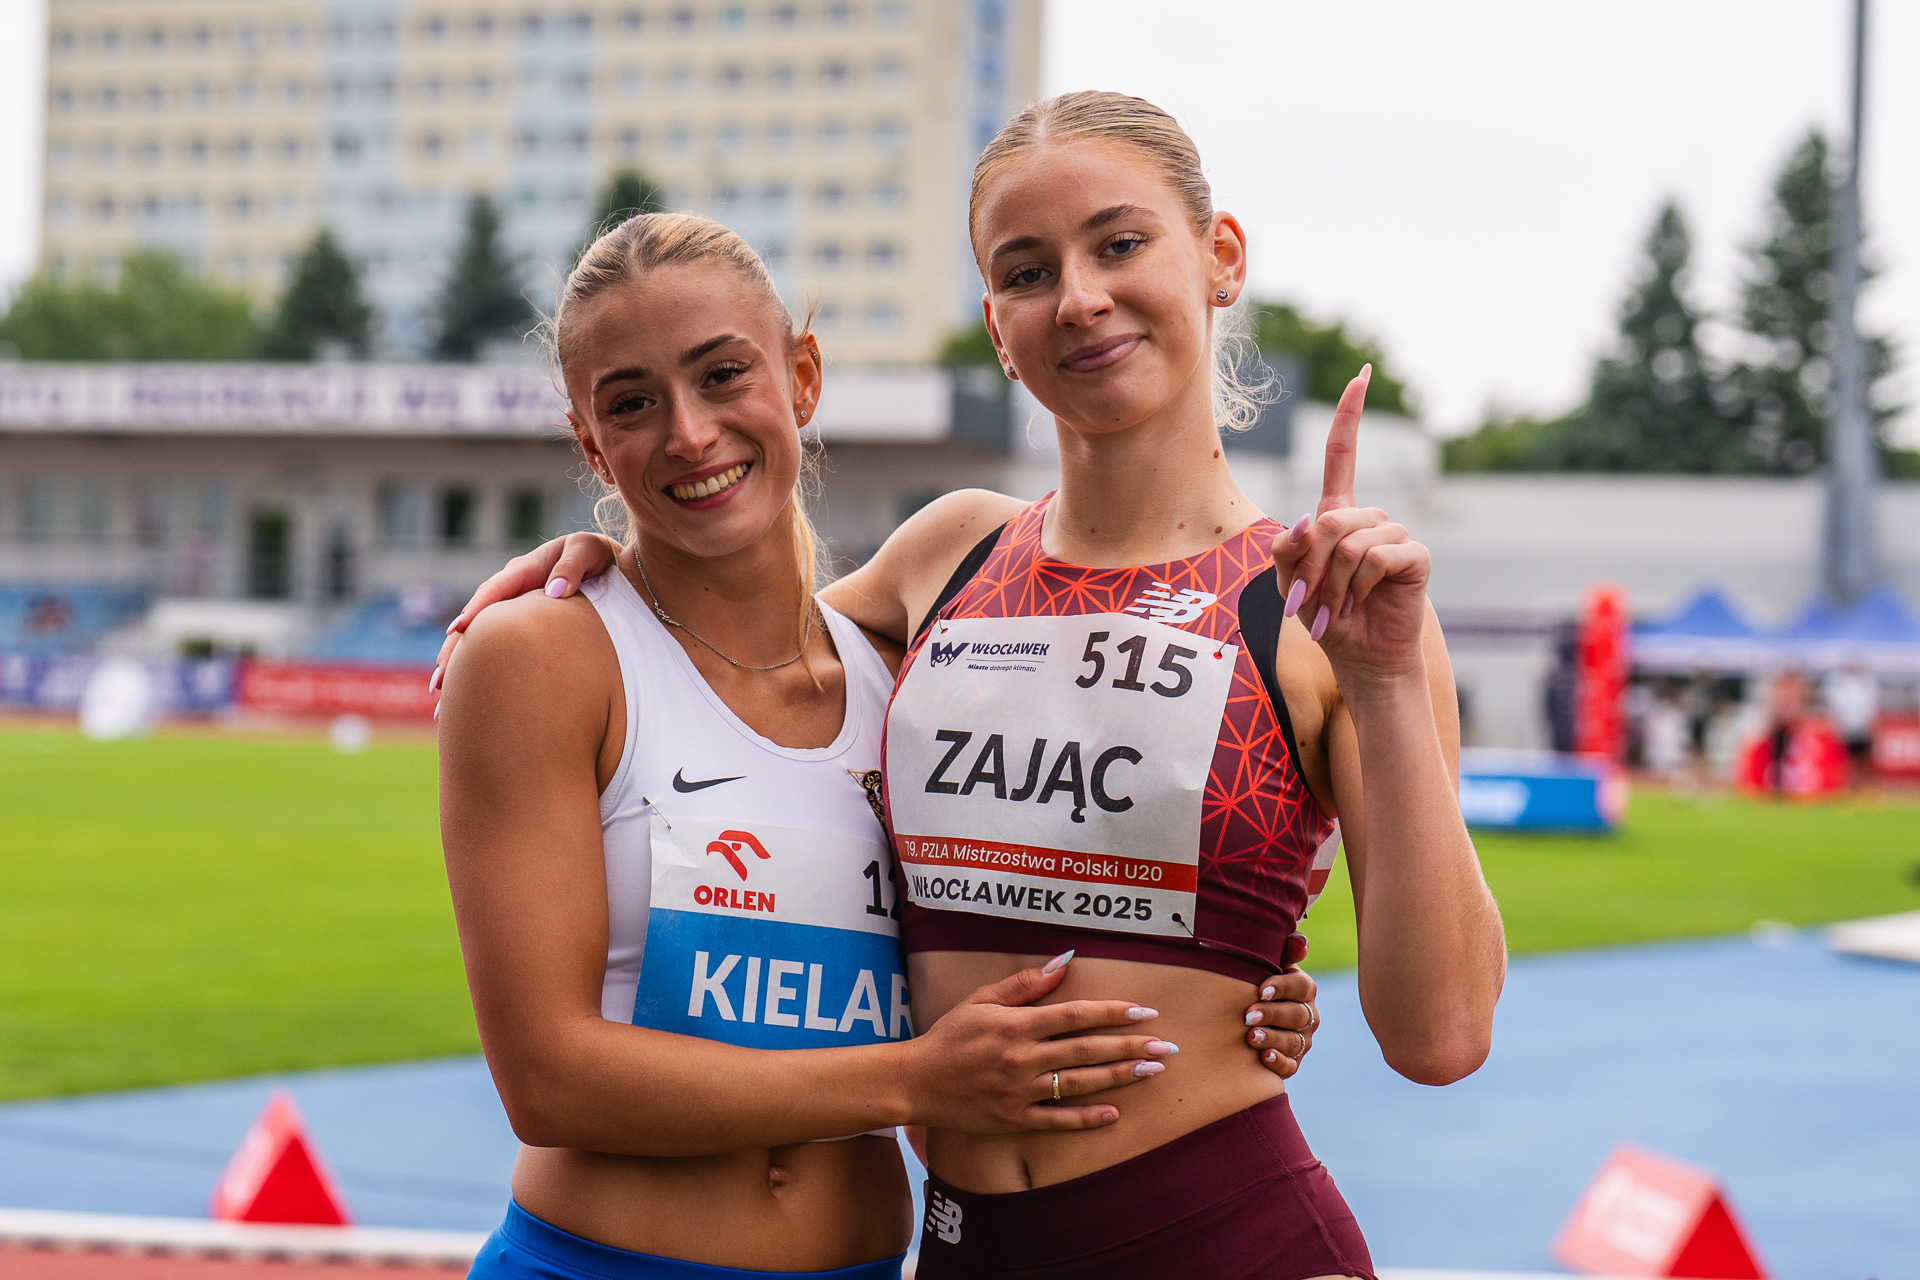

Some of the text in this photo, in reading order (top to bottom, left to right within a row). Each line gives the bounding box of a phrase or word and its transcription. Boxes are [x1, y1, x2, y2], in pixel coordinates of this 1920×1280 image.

[967, 663, 1037, 673] Miasto dobrego klimatu
[971, 642, 1050, 656] WŁOCŁAWEK
[1075, 631, 1198, 698] 515
[925, 729, 1143, 823] ZAJĄC
[921, 842, 949, 859] PZLA
[953, 844, 1056, 871] Mistrzostwa
[1061, 857, 1119, 878] Polski
[1124, 864, 1163, 882] U20
[694, 884, 776, 913] ORLEN
[912, 874, 1153, 921] WŁOCŁAWEK 2025
